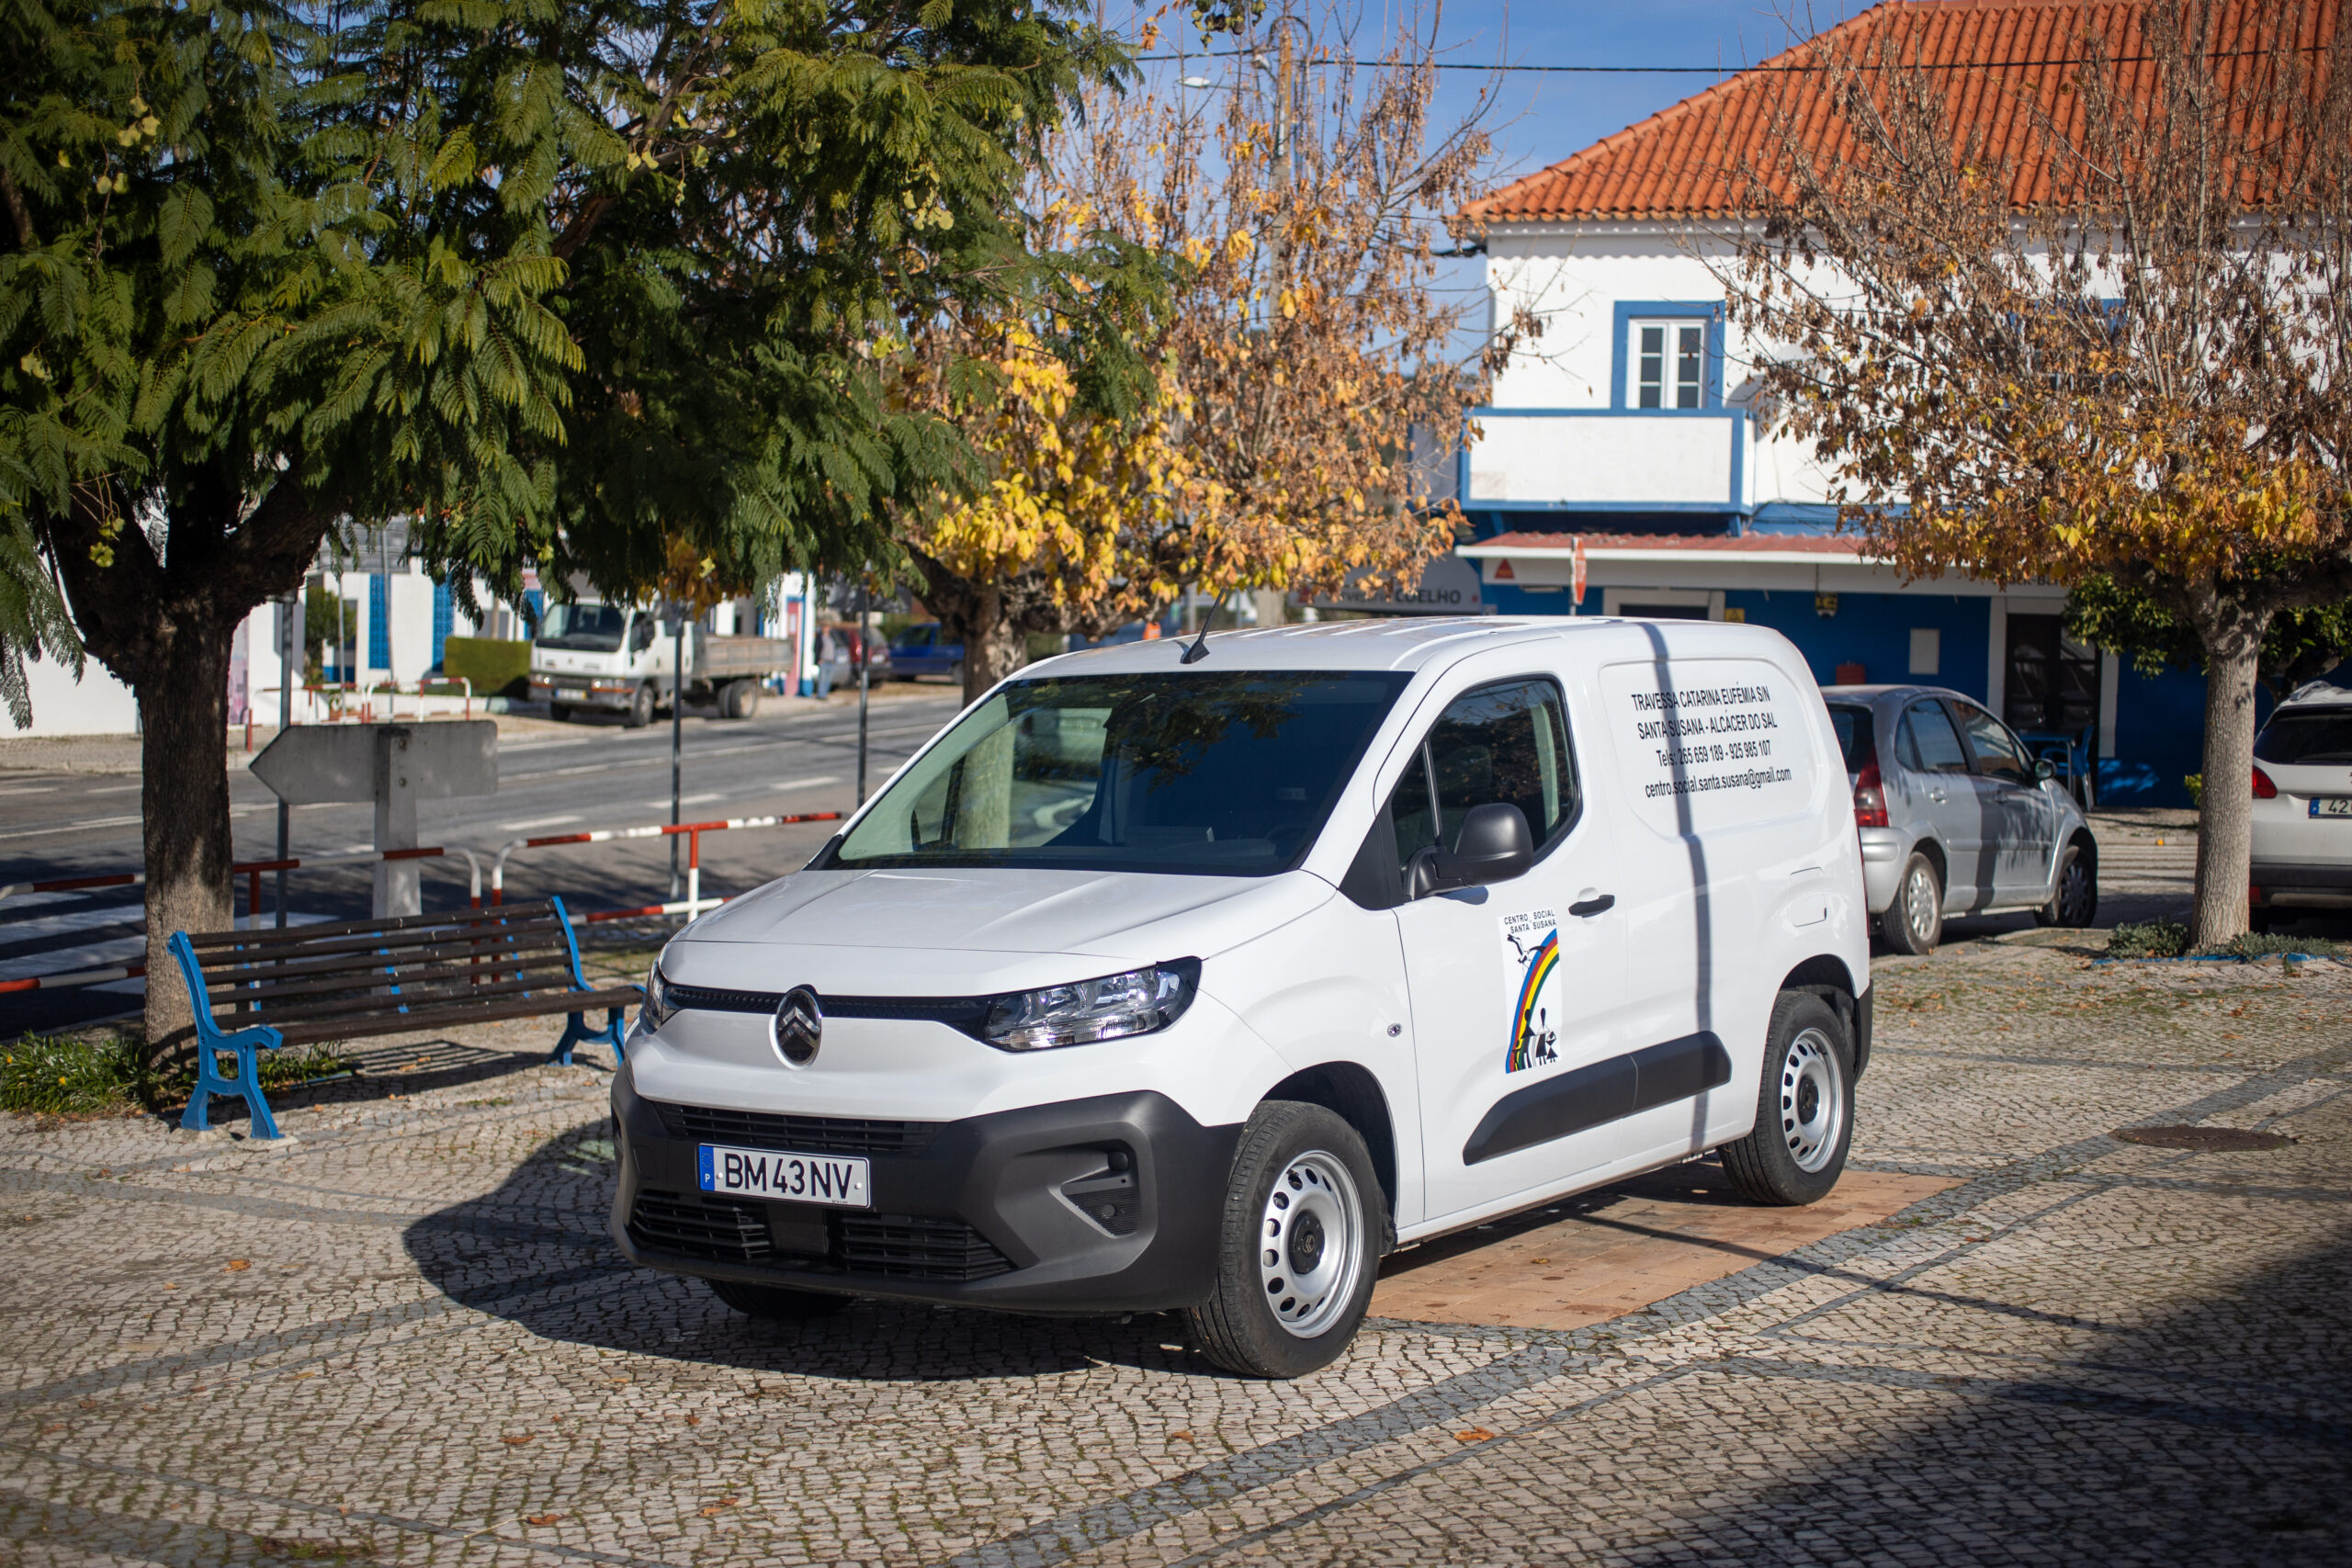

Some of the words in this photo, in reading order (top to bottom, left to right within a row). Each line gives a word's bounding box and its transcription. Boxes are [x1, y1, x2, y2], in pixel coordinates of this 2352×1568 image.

[1395, 588, 1462, 605] COELHO
[1632, 691, 1680, 711] TRAVESSA
[1679, 689, 1722, 707] CATARINA
[1721, 681, 1757, 705] EUFÉMIA
[1756, 686, 1770, 703] S/N
[1637, 720, 1668, 739] SANTA
[1668, 717, 1705, 737] SUSANA
[1710, 708, 1748, 733] ALCÁCER
[1747, 713, 1761, 729] DO
[1761, 712, 1778, 728] SAL
[1656, 749, 1678, 766] Tels:
[1678, 748, 1693, 764] 265
[1693, 745, 1709, 763] 659
[1710, 745, 1724, 761] 189
[1729, 742, 1744, 760] 925
[1744, 740, 1758, 758] 985
[1758, 739, 1770, 756] 107
[1645, 766, 1792, 798] centro.social.santa.susana@gmail.com
[1504, 913, 1528, 925] CENTRO
[1533, 908, 1555, 919] SOCIAL
[1510, 923, 1530, 934] SANTA
[1532, 919, 1556, 930] SUSANA
[705, 1173, 711, 1183] P
